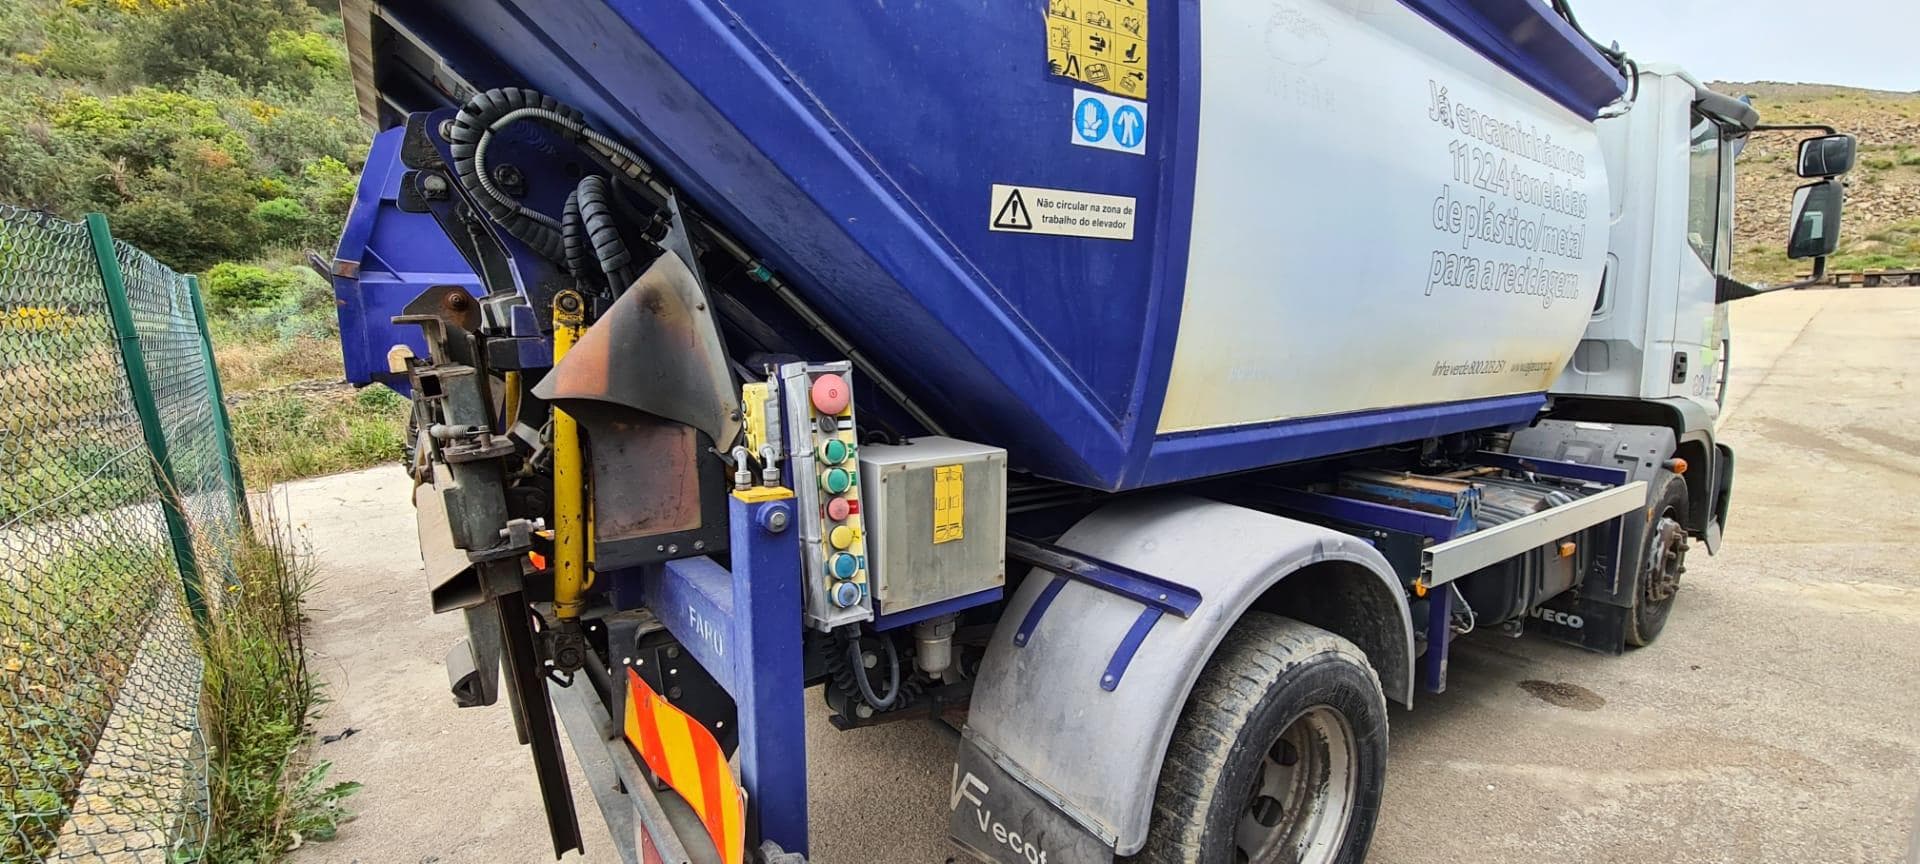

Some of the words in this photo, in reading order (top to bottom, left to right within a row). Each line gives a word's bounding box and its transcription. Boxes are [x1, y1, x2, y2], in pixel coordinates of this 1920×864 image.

[1429, 80, 1454, 128] Já
[1456, 103, 1585, 179] encaminhámos
[1036, 197, 1054, 208] Não
[1056, 200, 1088, 211] circular
[1090, 204, 1100, 212] na
[1102, 205, 1121, 214] zona
[1123, 205, 1133, 215] de
[1473, 147, 1509, 196] 224
[1511, 163, 1587, 219] toneladas
[1042, 214, 1077, 225] trabalho
[1079, 217, 1090, 226] do
[1092, 218, 1126, 229] elevador
[1433, 184, 1462, 234] de
[1463, 196, 1585, 259] plástico/metal
[1424, 250, 1480, 296] para
[1481, 261, 1494, 290] a
[1495, 257, 1578, 309] reciclagem.
